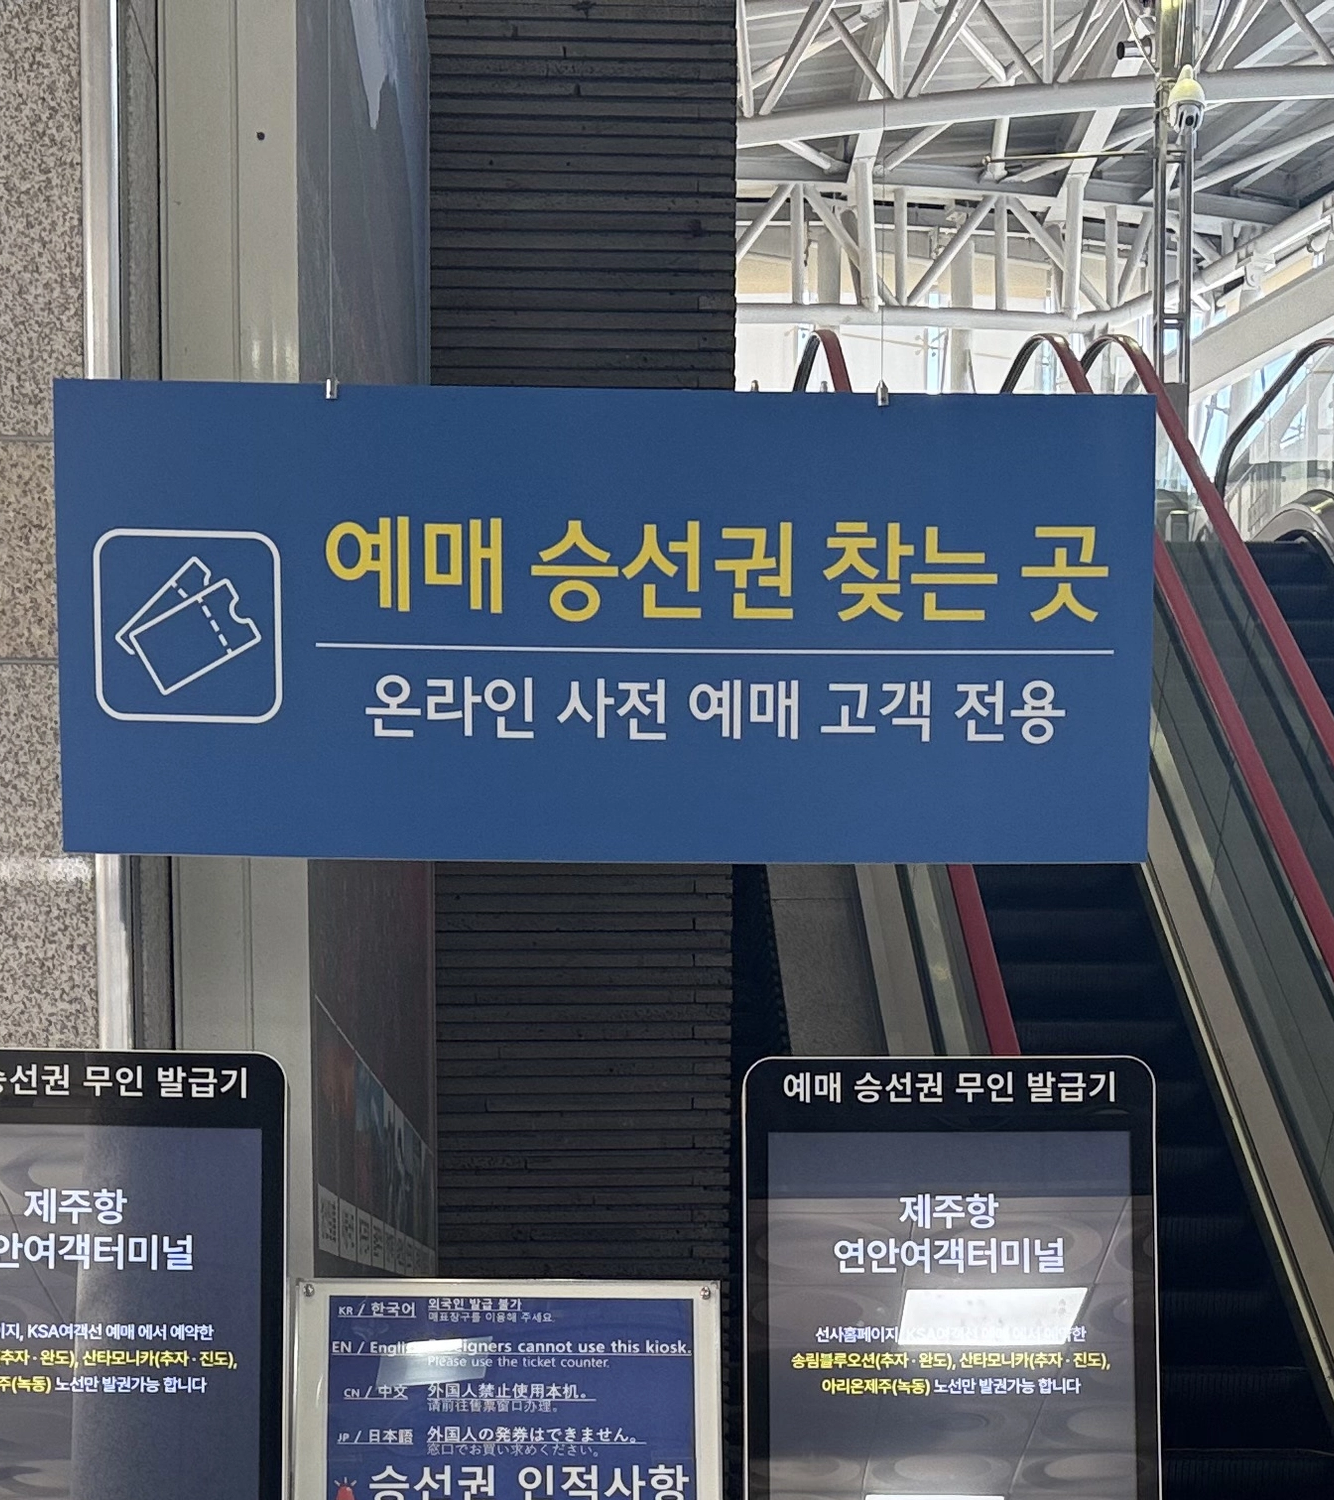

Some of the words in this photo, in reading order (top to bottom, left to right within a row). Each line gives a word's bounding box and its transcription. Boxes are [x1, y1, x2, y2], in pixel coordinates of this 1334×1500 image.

[325, 516, 504, 613] 예매
[531, 519, 795, 621] 승선권
[823, 521, 998, 622] 찾는
[1020, 525, 1109, 624] 곳
[365, 674, 533, 739] 온라인
[557, 676, 666, 741] 사전
[688, 678, 799, 741] 예매
[820, 678, 932, 742] 고객
[954, 680, 1066, 744] 전용
[83, 1065, 144, 1097] 무인
[157, 1066, 248, 1099] 발급기
[783, 1071, 842, 1103] 예매
[854, 1072, 944, 1103] 승선권
[955, 1072, 1014, 1103] 무인
[1027, 1071, 1116, 1103] 발급기
[24, 1188, 128, 1224] 제주항
[899, 1193, 999, 1229] 제주항
[834, 1237, 1066, 1273] 연안여객터미널
[338, 1307, 353, 1315] KR
[371, 1302, 416, 1317] 한국어
[428, 1298, 464, 1310] 외국인
[469, 1298, 493, 1310] 발급
[498, 1298, 522, 1310] 불가
[28, 1323, 102, 1340] KSA여객선
[106, 1324, 134, 1340] 예매
[138, 1324, 166, 1340] 에서
[170, 1324, 214, 1341] 예약한
[332, 1341, 352, 1353] EN
[518, 1340, 572, 1353] cannot
[579, 1342, 605, 1353] use
[611, 1340, 639, 1353] this
[646, 1340, 692, 1353] kiosk.
[40, 1350, 79, 1368] 완도),
[83, 1350, 188, 1368] 산타모니카(추자
[200, 1351, 237, 1369] 진도),
[428, 1357, 467, 1367] Please
[472, 1359, 493, 1367] use
[497, 1357, 517, 1367] the
[523, 1357, 556, 1368] ticket
[561, 1358, 609, 1368] counter.
[791, 1352, 908, 1370] 송림블루오션(추자
[919, 1353, 956, 1370] 완도),
[959, 1352, 1063, 1370] 산타모니카(추자
[1073, 1353, 1111, 1370] 진도),
[55, 1376, 98, 1392] 노선만
[102, 1376, 160, 1393] 발권가능
[163, 1377, 207, 1393] 합니다
[344, 1388, 360, 1398] CN
[378, 1385, 408, 1398] 中文
[427, 1383, 587, 1398] 外国人禁止使用本机。
[822, 1378, 930, 1396] 아리온제주(녹동)
[934, 1378, 976, 1394] 노선만
[979, 1378, 1035, 1394] 발권가능
[1038, 1378, 1081, 1394] 합니다
[337, 1433, 349, 1442] JP
[369, 1429, 413, 1443] 日本語
[427, 1426, 637, 1443] 外国人の発券はできません。
